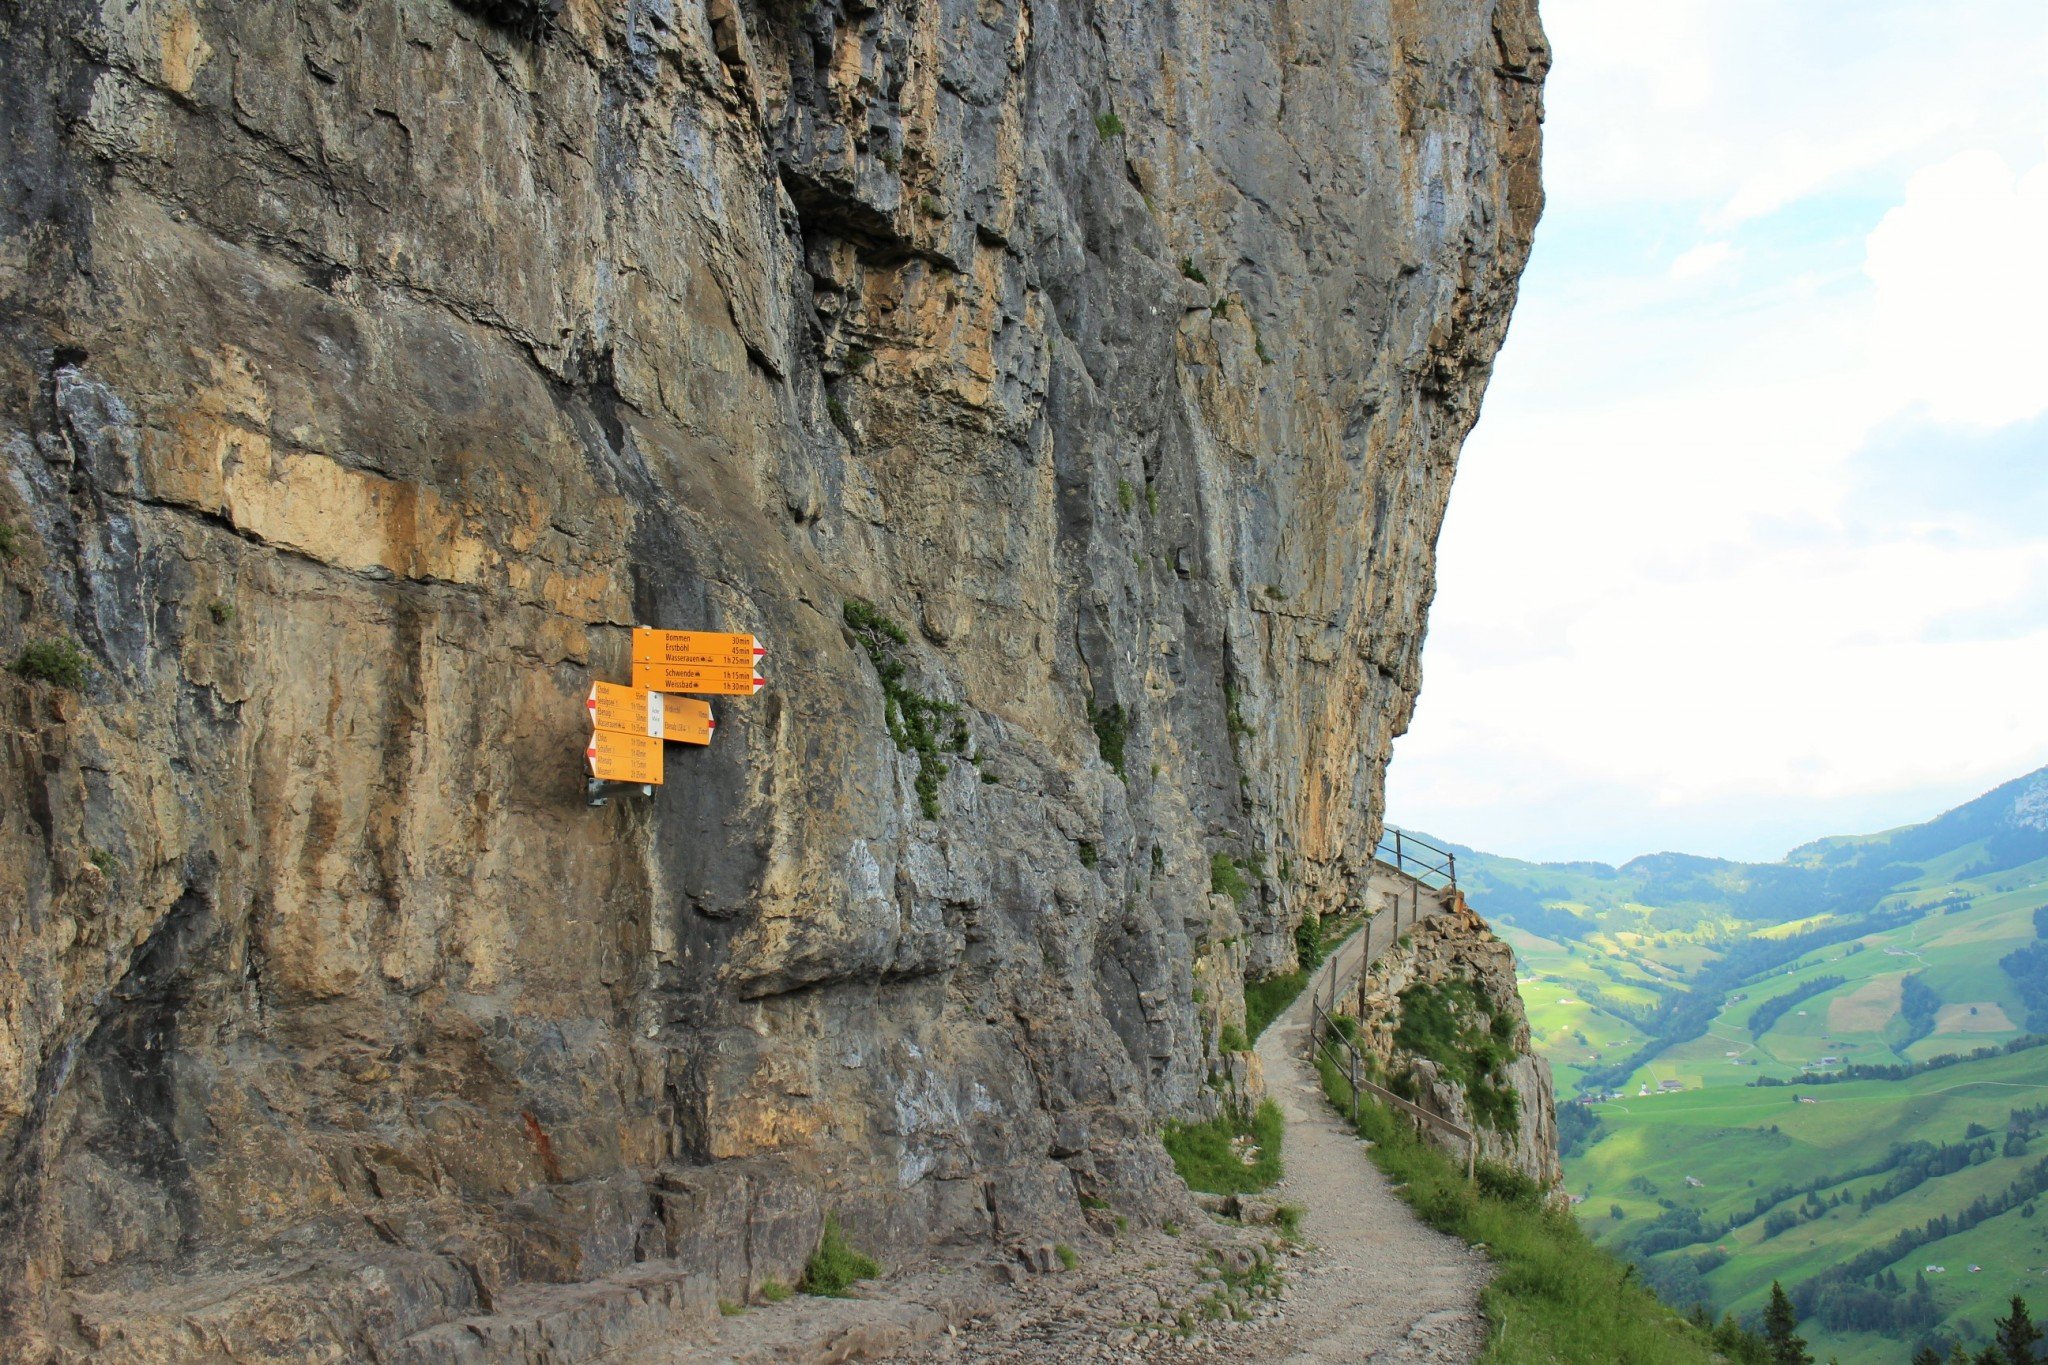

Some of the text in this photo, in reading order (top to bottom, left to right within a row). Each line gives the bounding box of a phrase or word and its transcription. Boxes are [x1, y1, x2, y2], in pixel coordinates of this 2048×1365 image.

[665, 633, 691, 642] Bommen
[732, 637, 750, 645] 30min
[665, 643, 690, 652] Erstböhl
[732, 647, 750, 655] 45min
[665, 653, 700, 662] Wasserauen
[723, 656, 750, 665] 1h 25min
[665, 668, 695, 677] Schwende
[723, 671, 750, 680] 1h 15min
[665, 680, 693, 688] Weissbad
[723, 682, 750, 691] 1h 30min
